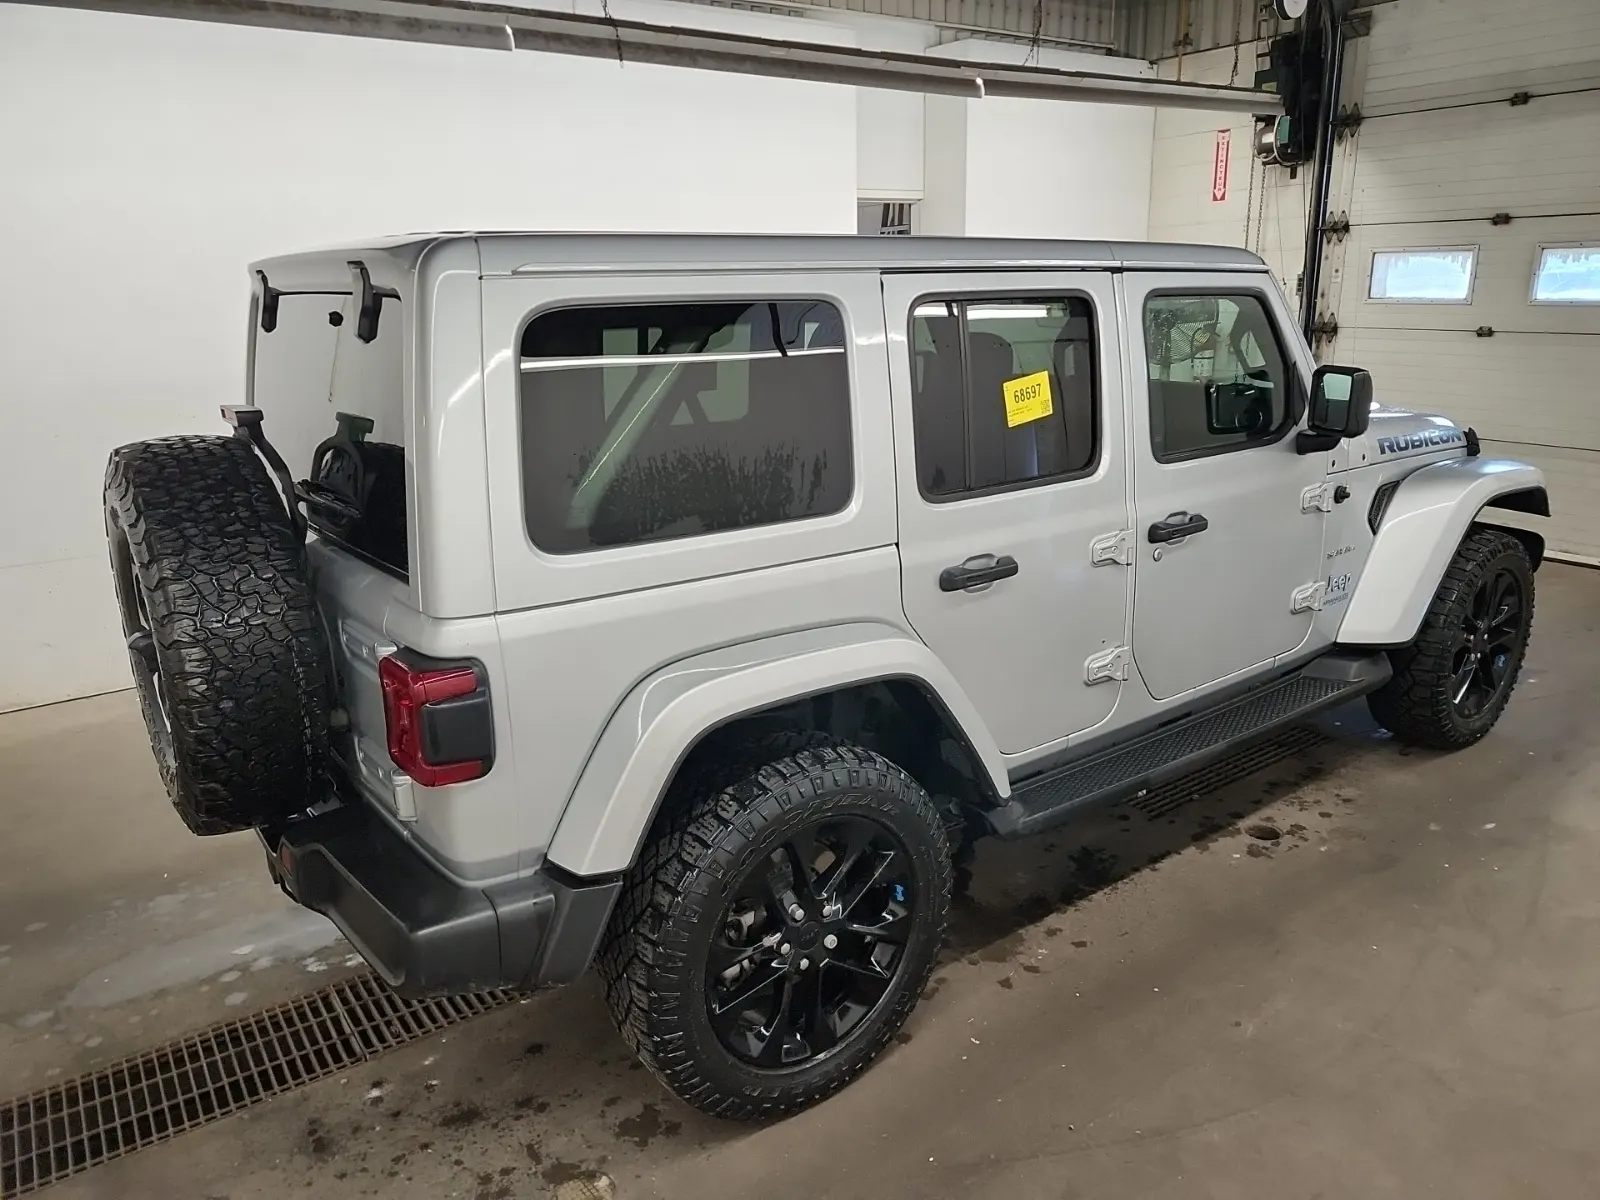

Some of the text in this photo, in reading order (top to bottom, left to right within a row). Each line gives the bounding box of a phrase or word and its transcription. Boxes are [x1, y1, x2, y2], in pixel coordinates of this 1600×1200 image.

[1217, 135, 1226, 192] EXTINCTEUR
[1013, 383, 1041, 404] 68697
[1377, 428, 1462, 455] RUBICON
[1325, 572, 1352, 594] Jeep
